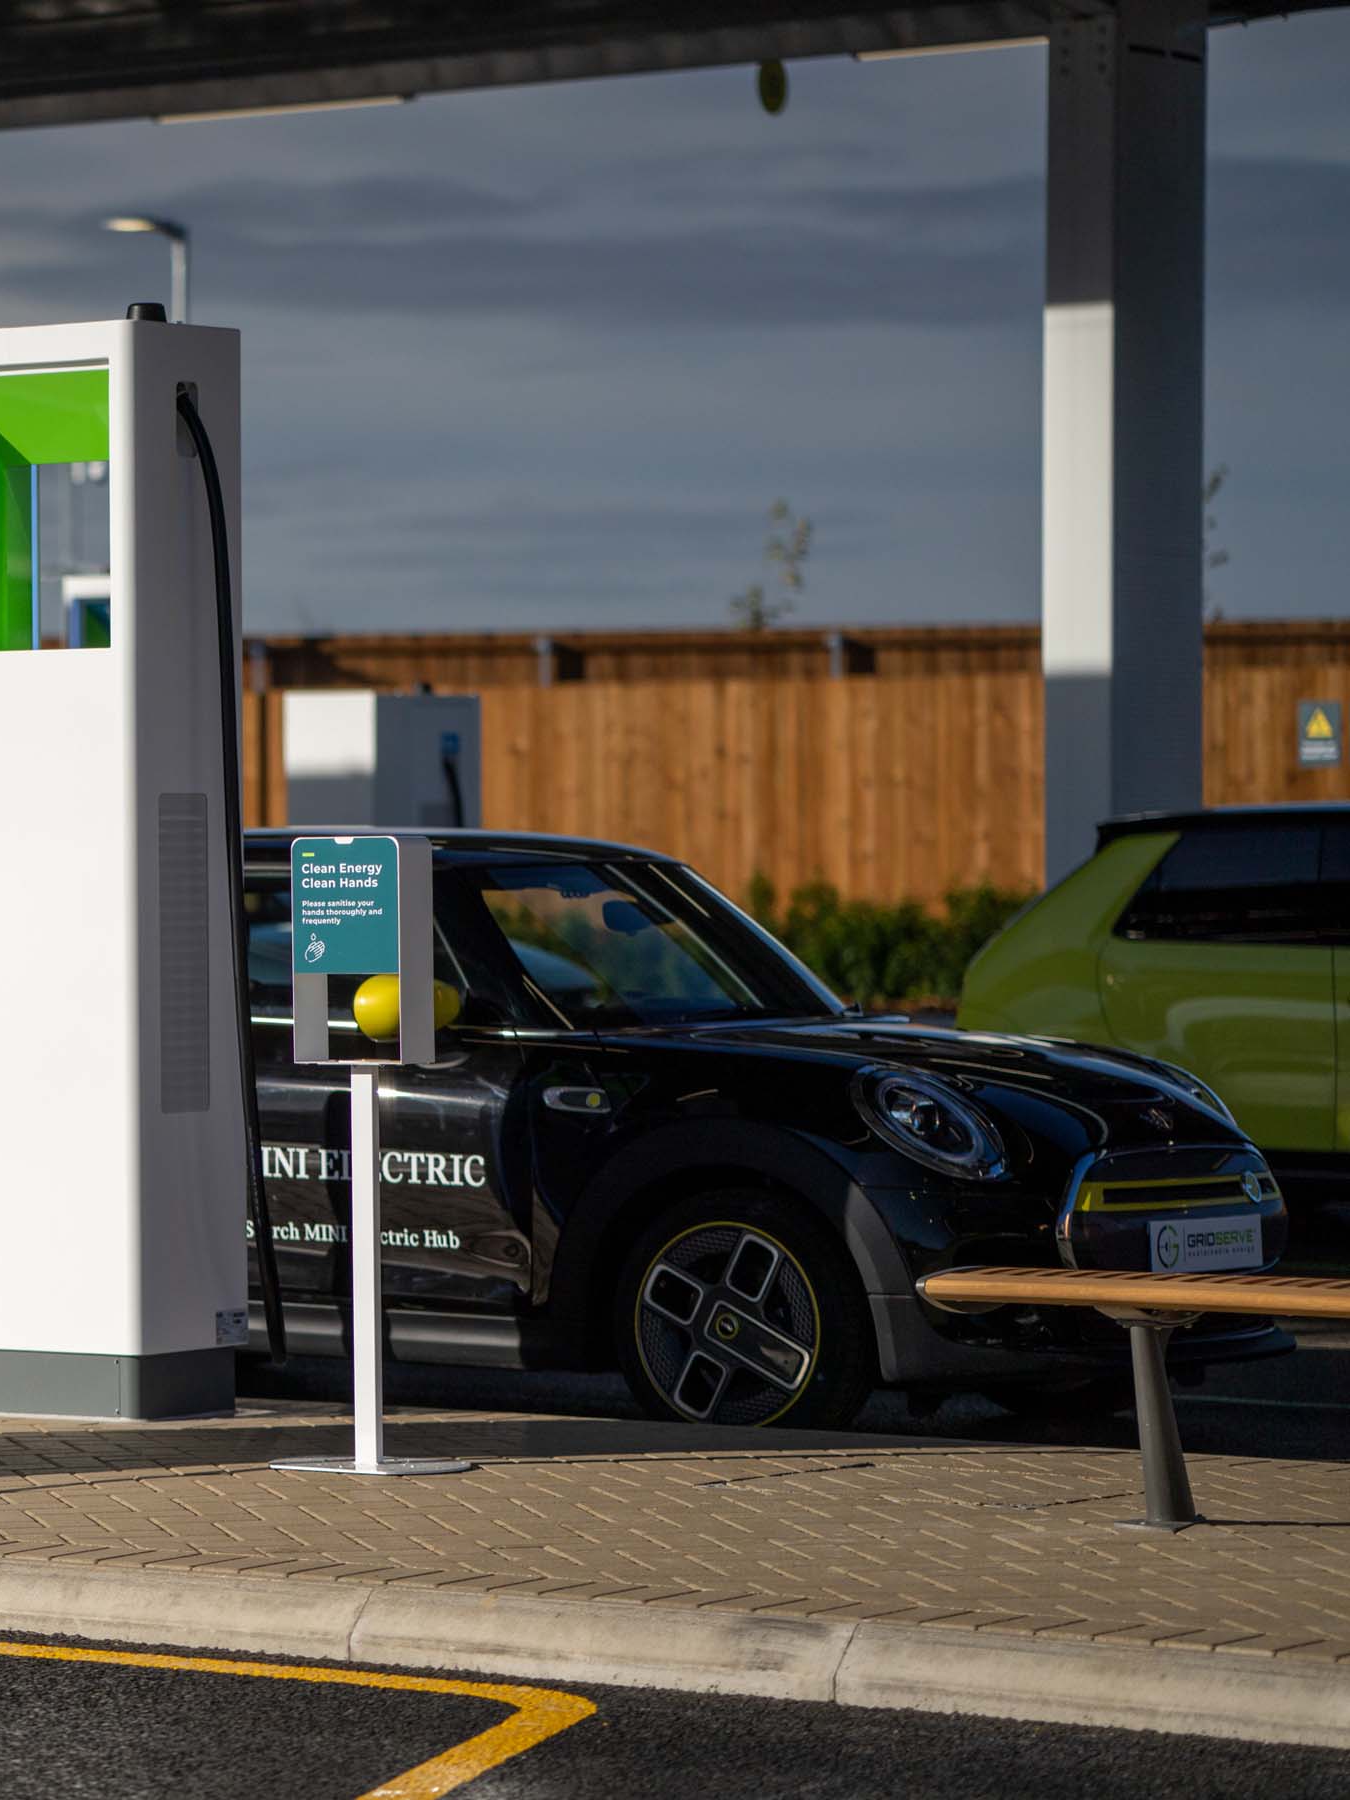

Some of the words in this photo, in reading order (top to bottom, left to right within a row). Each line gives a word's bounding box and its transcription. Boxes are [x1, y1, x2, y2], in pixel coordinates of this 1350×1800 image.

[301, 863, 336, 874] Clean
[339, 862, 383, 875] Energy
[301, 878, 336, 888] Clean
[339, 877, 379, 888] Hands
[301, 899, 326, 907] Please
[327, 899, 356, 907] sanitise
[357, 900, 374, 909] your
[302, 908, 325, 916] hands
[326, 908, 367, 917] thoroughly
[302, 917, 341, 926] frequently
[261, 1146, 310, 1180] INI
[318, 1148, 486, 1187] ELCTRIC
[246, 1220, 300, 1241] Srch
[303, 1222, 348, 1243] MINI
[380, 1228, 420, 1247] ctric
[422, 1229, 461, 1249] Hub
[1187, 1228, 1255, 1248] GRIDSERVE
